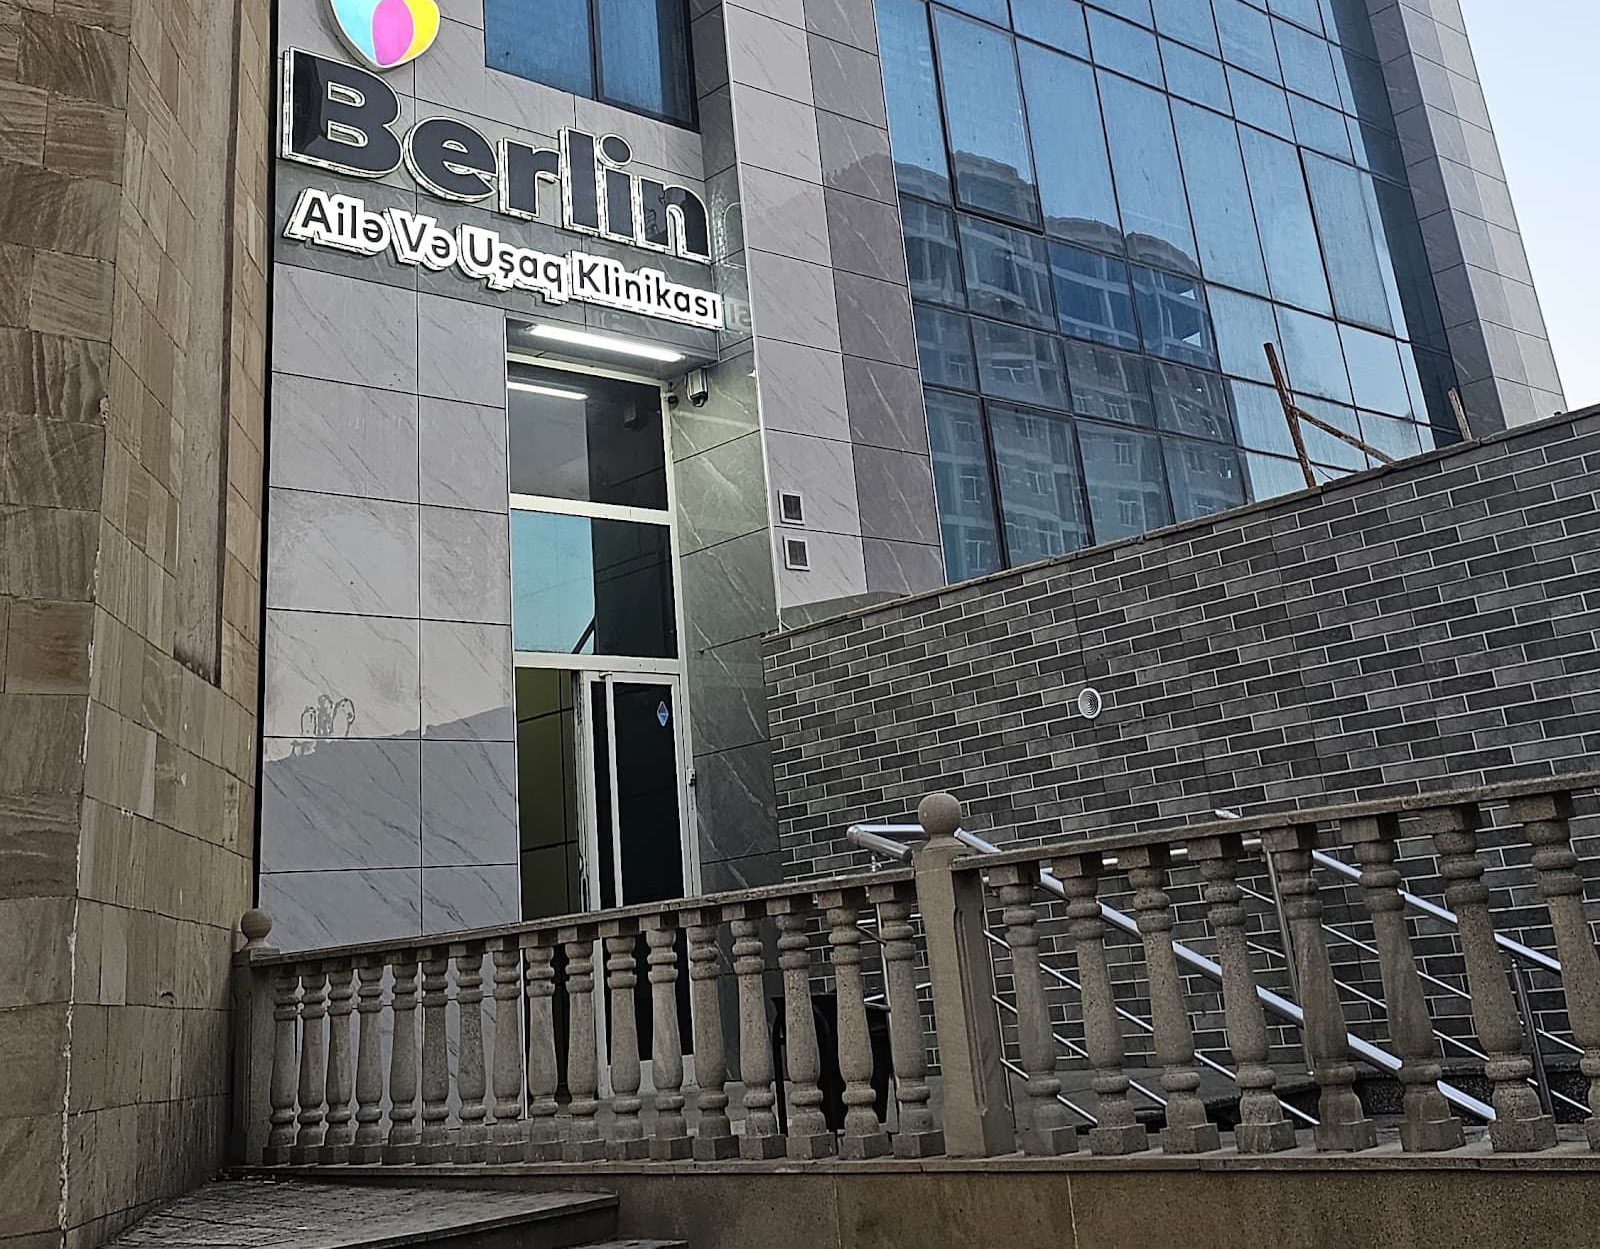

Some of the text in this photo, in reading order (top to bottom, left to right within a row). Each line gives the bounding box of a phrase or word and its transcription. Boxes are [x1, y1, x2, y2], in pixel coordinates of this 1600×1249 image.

[284, 47, 714, 262] Berlin
[299, 196, 719, 321] Ailə Və Uşaq Klinikası
